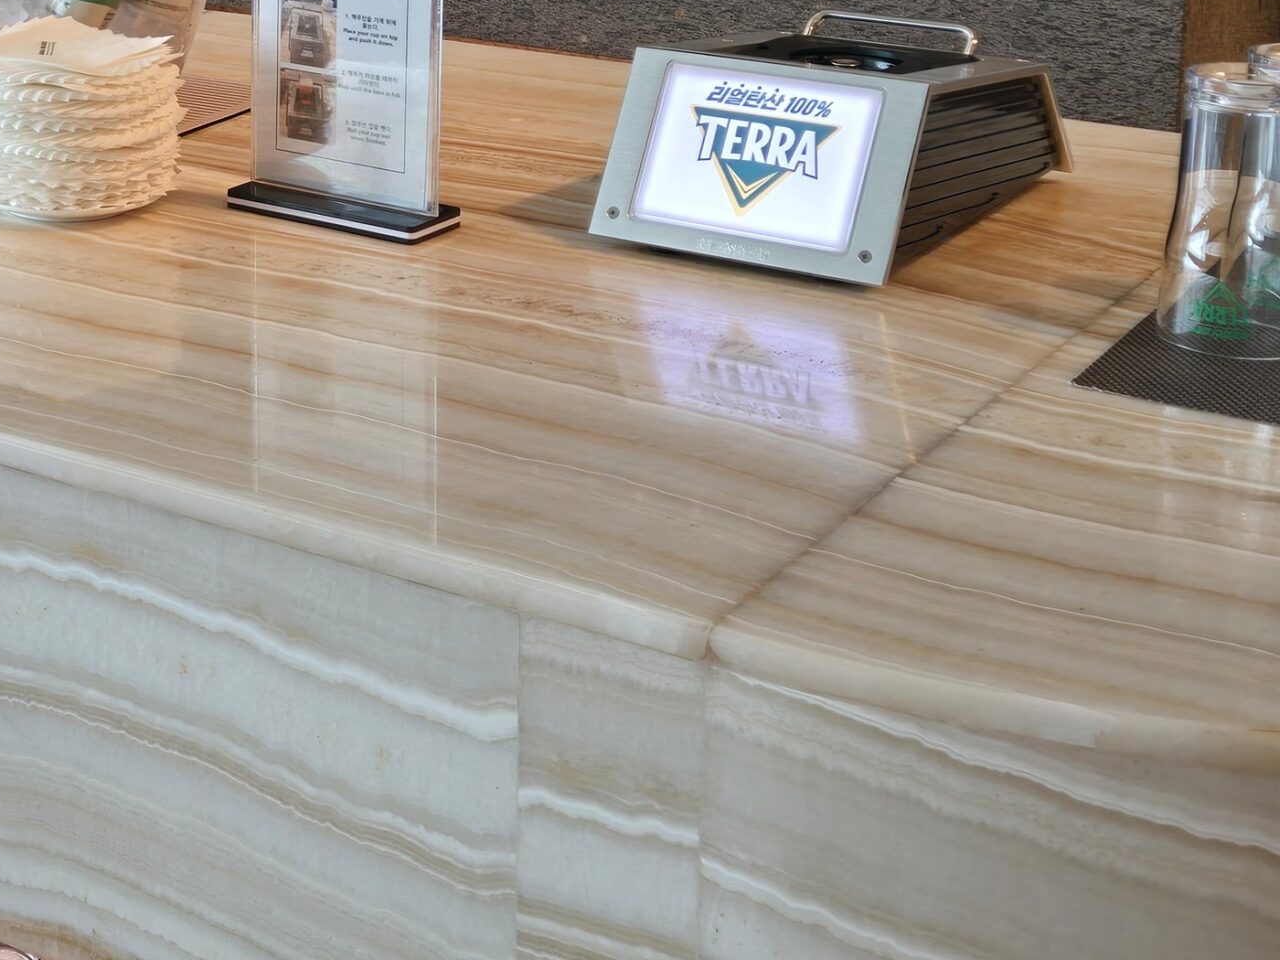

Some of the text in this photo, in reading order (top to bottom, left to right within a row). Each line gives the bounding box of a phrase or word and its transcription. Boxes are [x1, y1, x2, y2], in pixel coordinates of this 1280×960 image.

[706, 81, 834, 118] 리얼탄산 100%
[697, 115, 818, 180] TERRA
